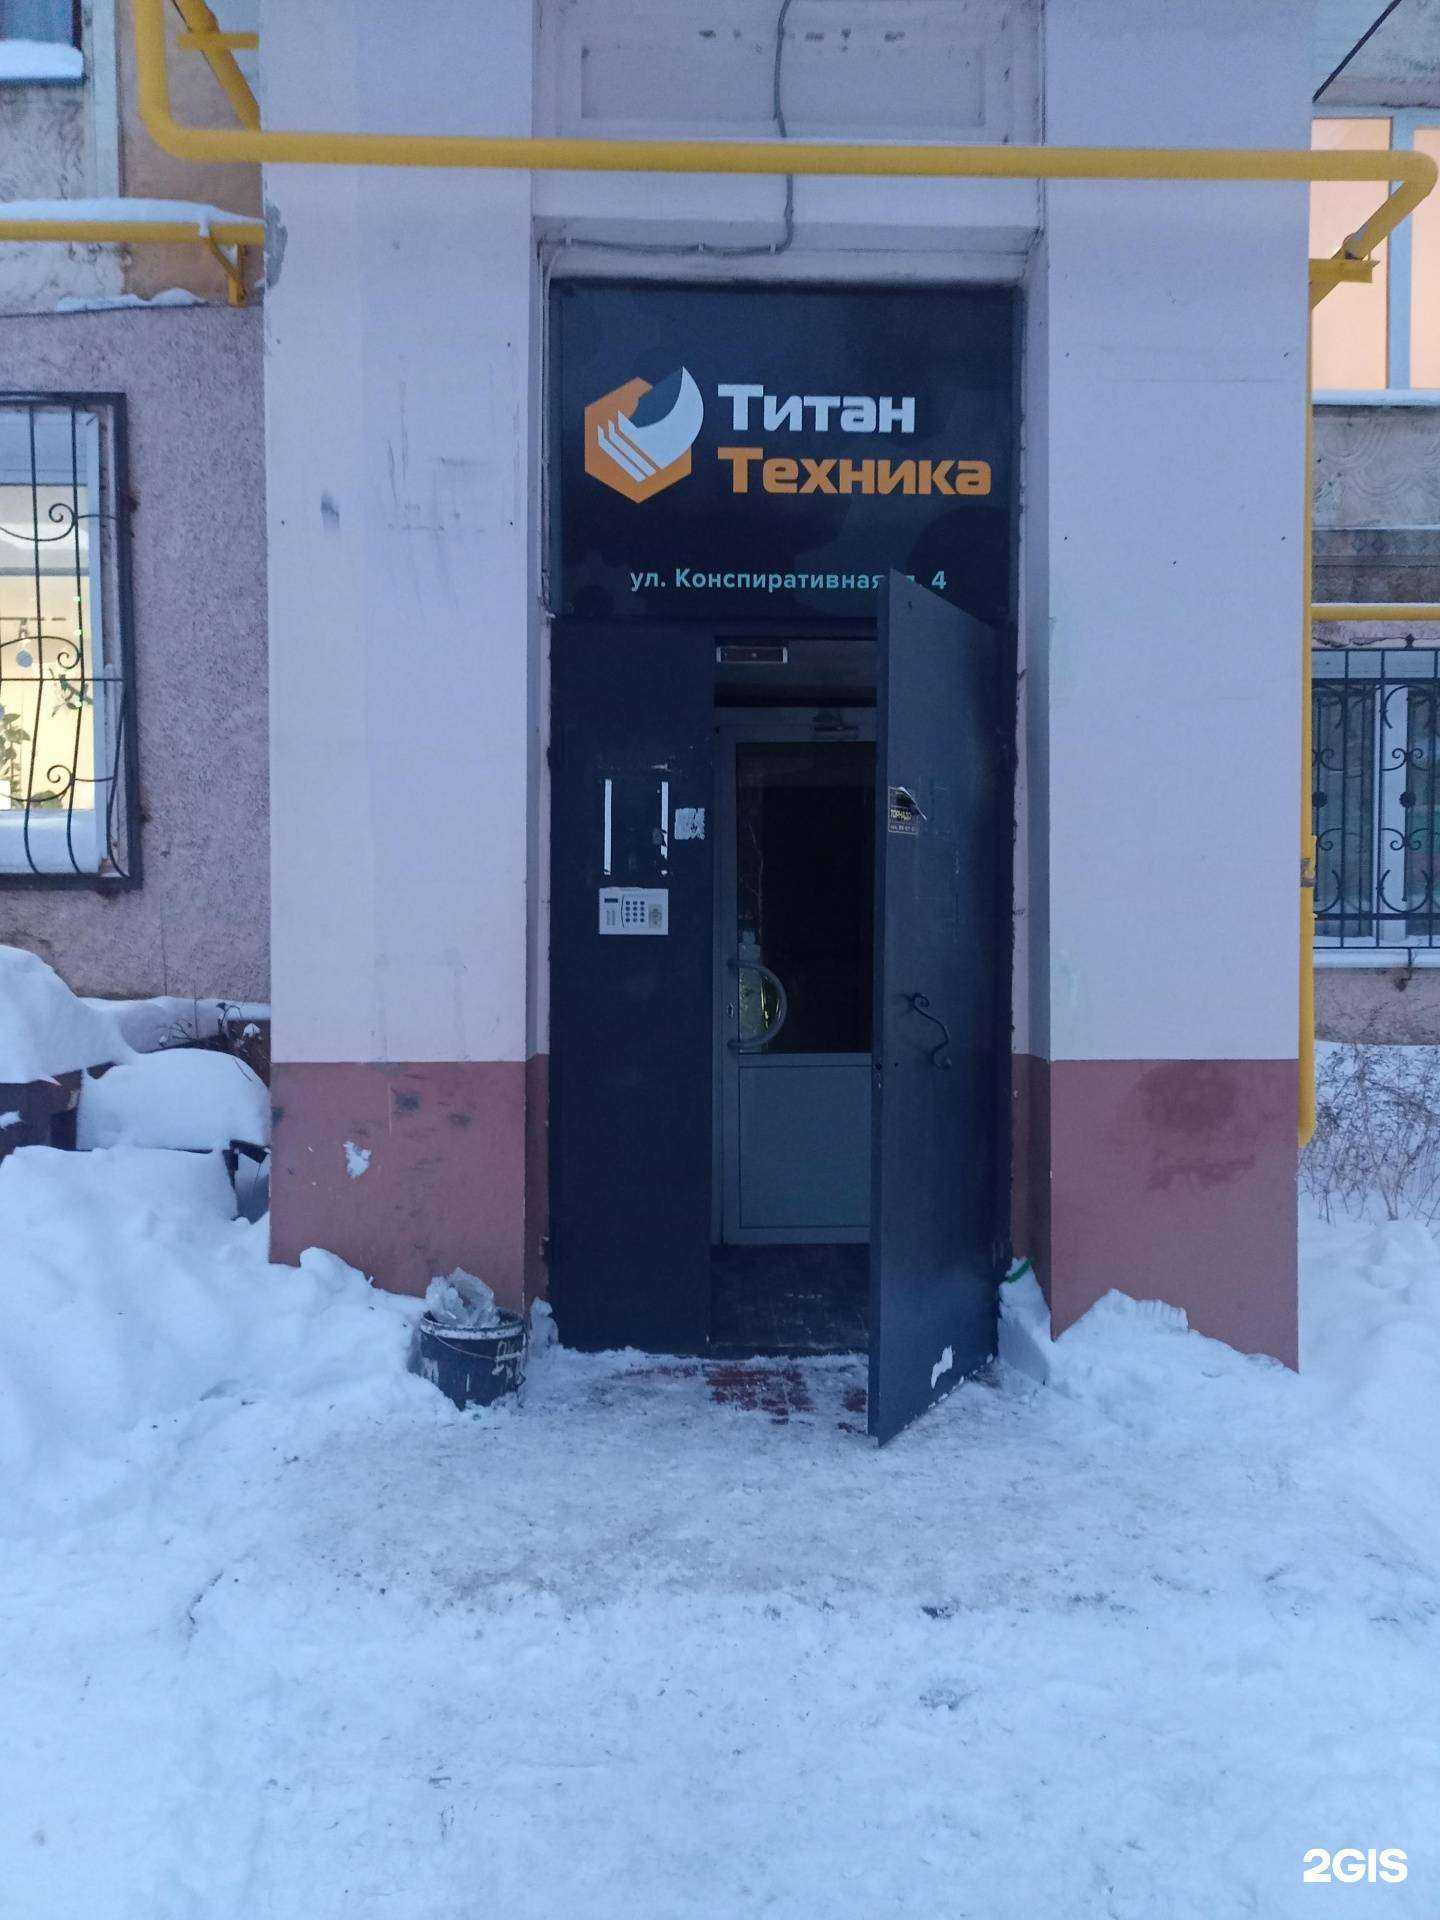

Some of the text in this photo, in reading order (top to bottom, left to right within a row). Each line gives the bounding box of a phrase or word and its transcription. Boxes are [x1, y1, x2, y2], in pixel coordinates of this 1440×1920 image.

[717, 384, 916, 433] Титан
[717, 447, 992, 495] Техника
[630, 572, 666, 592] ул.
[931, 570, 947, 589] 4
